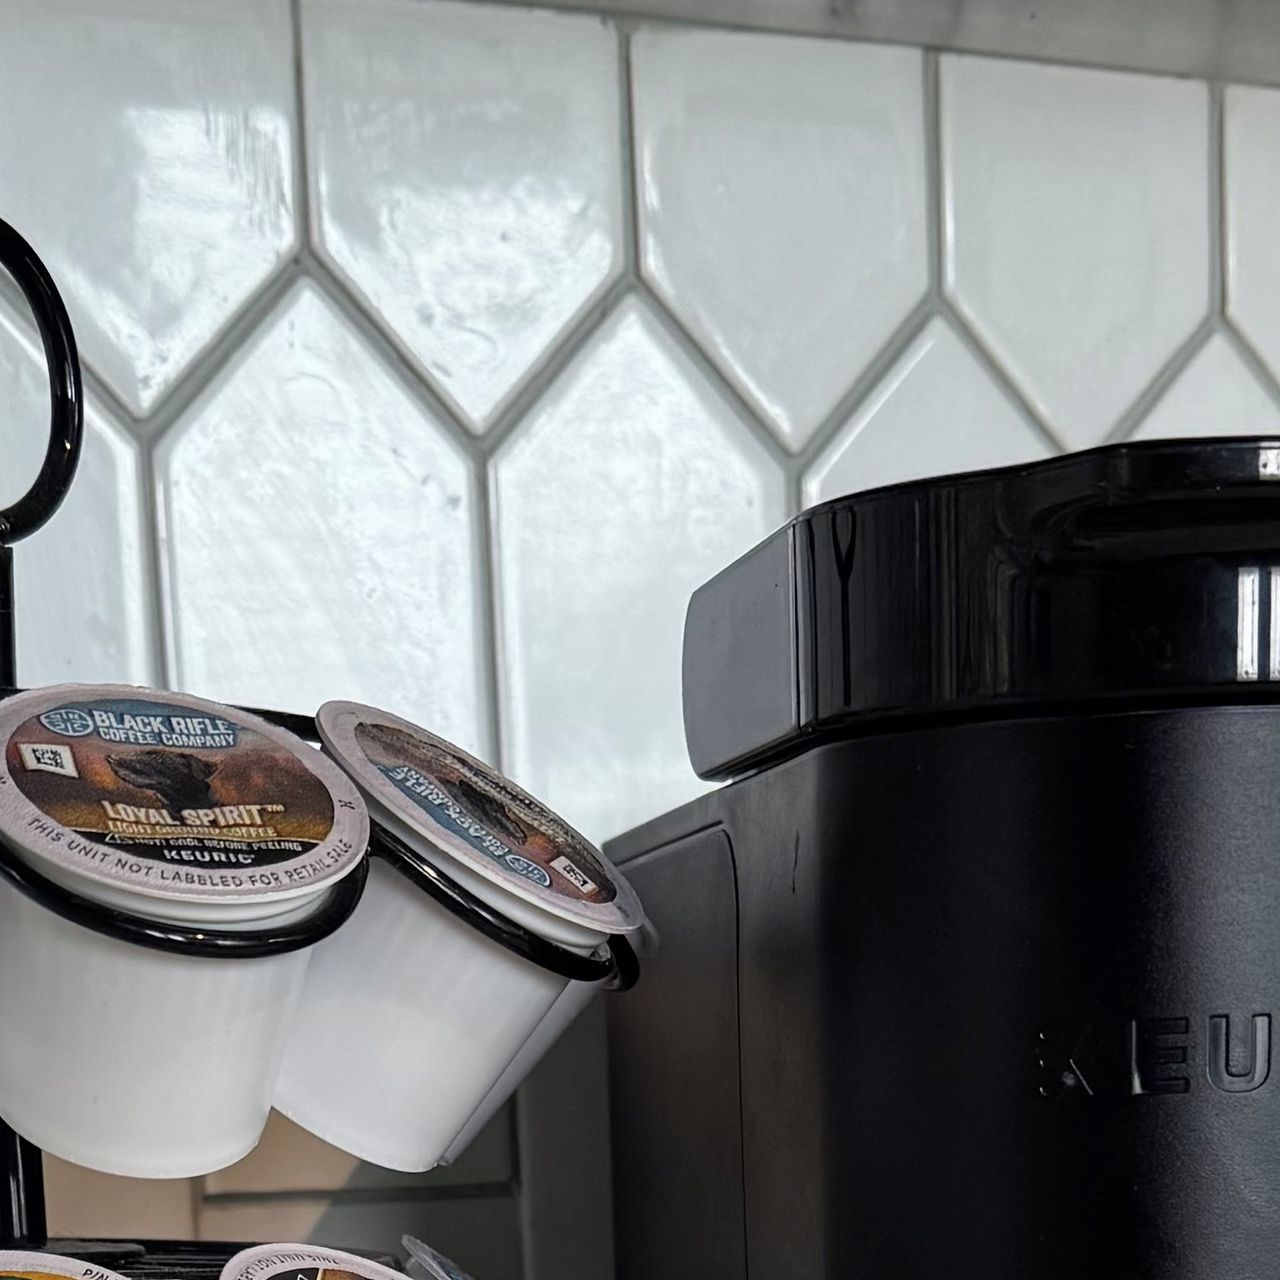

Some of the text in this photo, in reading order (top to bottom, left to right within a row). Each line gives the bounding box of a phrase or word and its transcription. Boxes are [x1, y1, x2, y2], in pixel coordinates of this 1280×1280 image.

[93, 710, 231, 735] BLACK RIFLE
[161, 733, 235, 748] COMPANY
[102, 801, 174, 825] LOYAL
[67, 838, 153, 879] UNIT NOT
[164, 848, 255, 865] KEURIG
